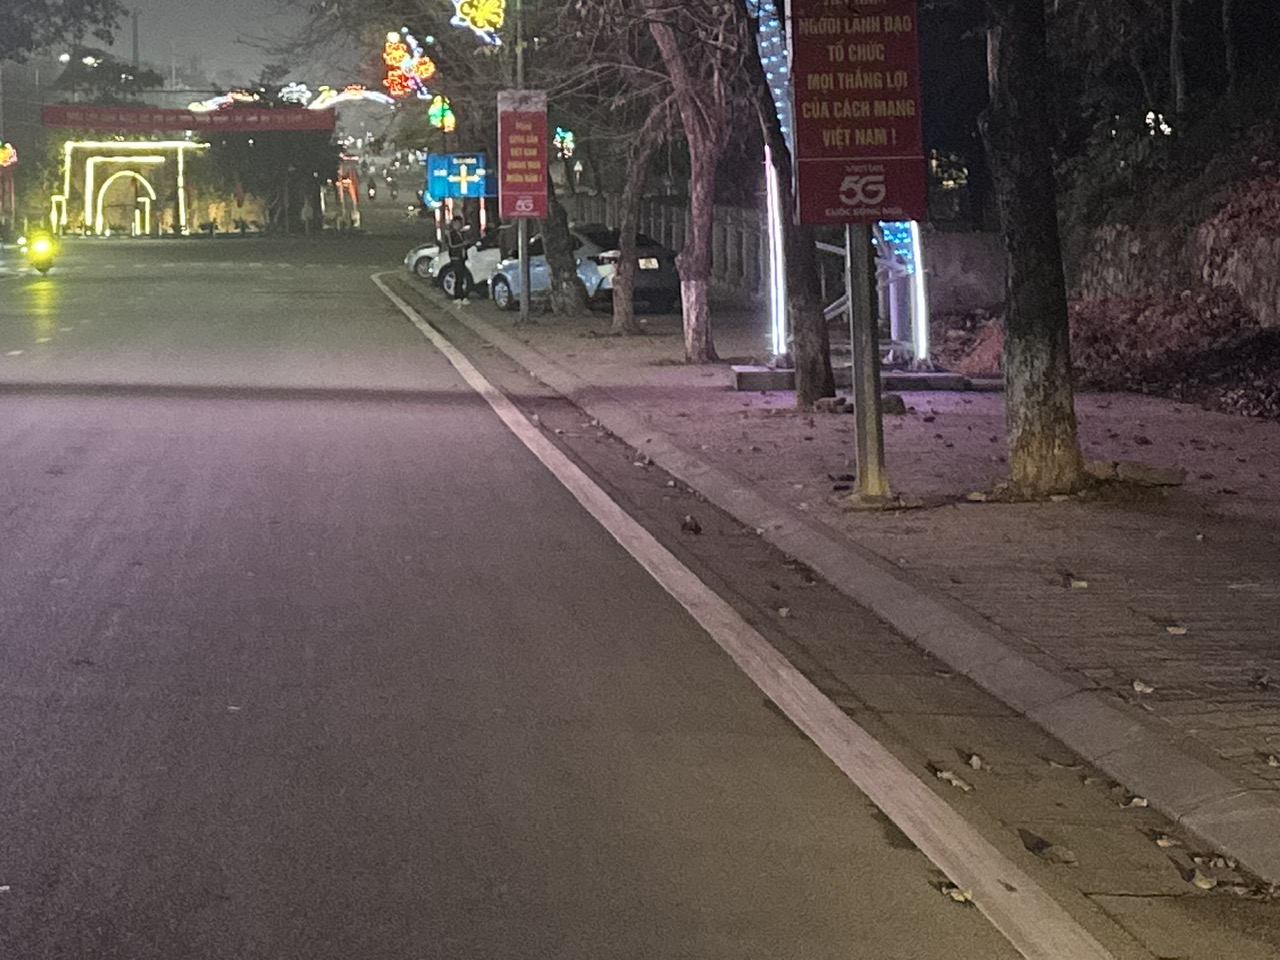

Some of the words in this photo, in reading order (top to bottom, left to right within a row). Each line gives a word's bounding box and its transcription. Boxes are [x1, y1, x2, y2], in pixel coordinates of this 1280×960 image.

[807, 72, 834, 93] MỌI
[802, 98, 830, 119] CỦA
[833, 98, 870, 118] CÁCH
[822, 126, 851, 149] VIỆT
[855, 127, 888, 146] NAM
[838, 175, 887, 206] 5G
